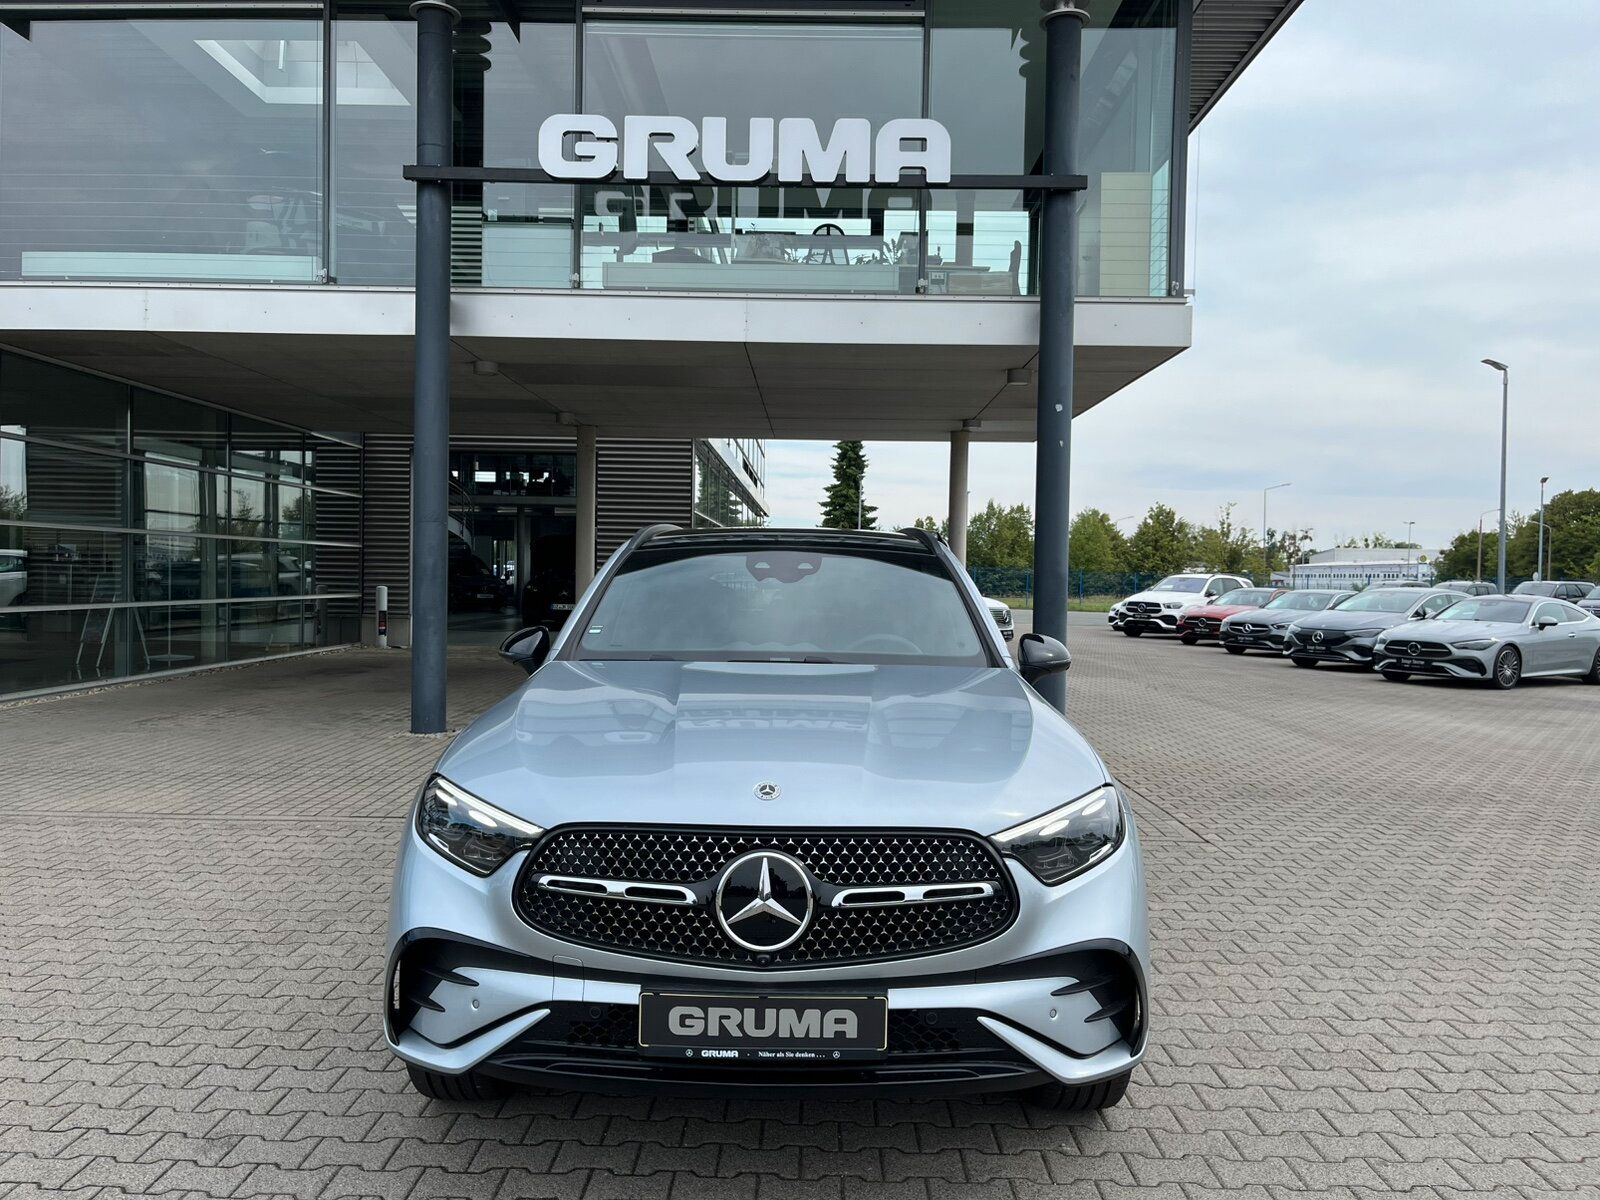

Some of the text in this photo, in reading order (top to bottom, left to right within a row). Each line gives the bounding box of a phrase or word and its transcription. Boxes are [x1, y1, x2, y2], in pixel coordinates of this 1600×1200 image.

[538, 113, 951, 183] GRUMA
[668, 1005, 858, 1039] GRUMA
[701, 1049, 739, 1058] GRUMA
